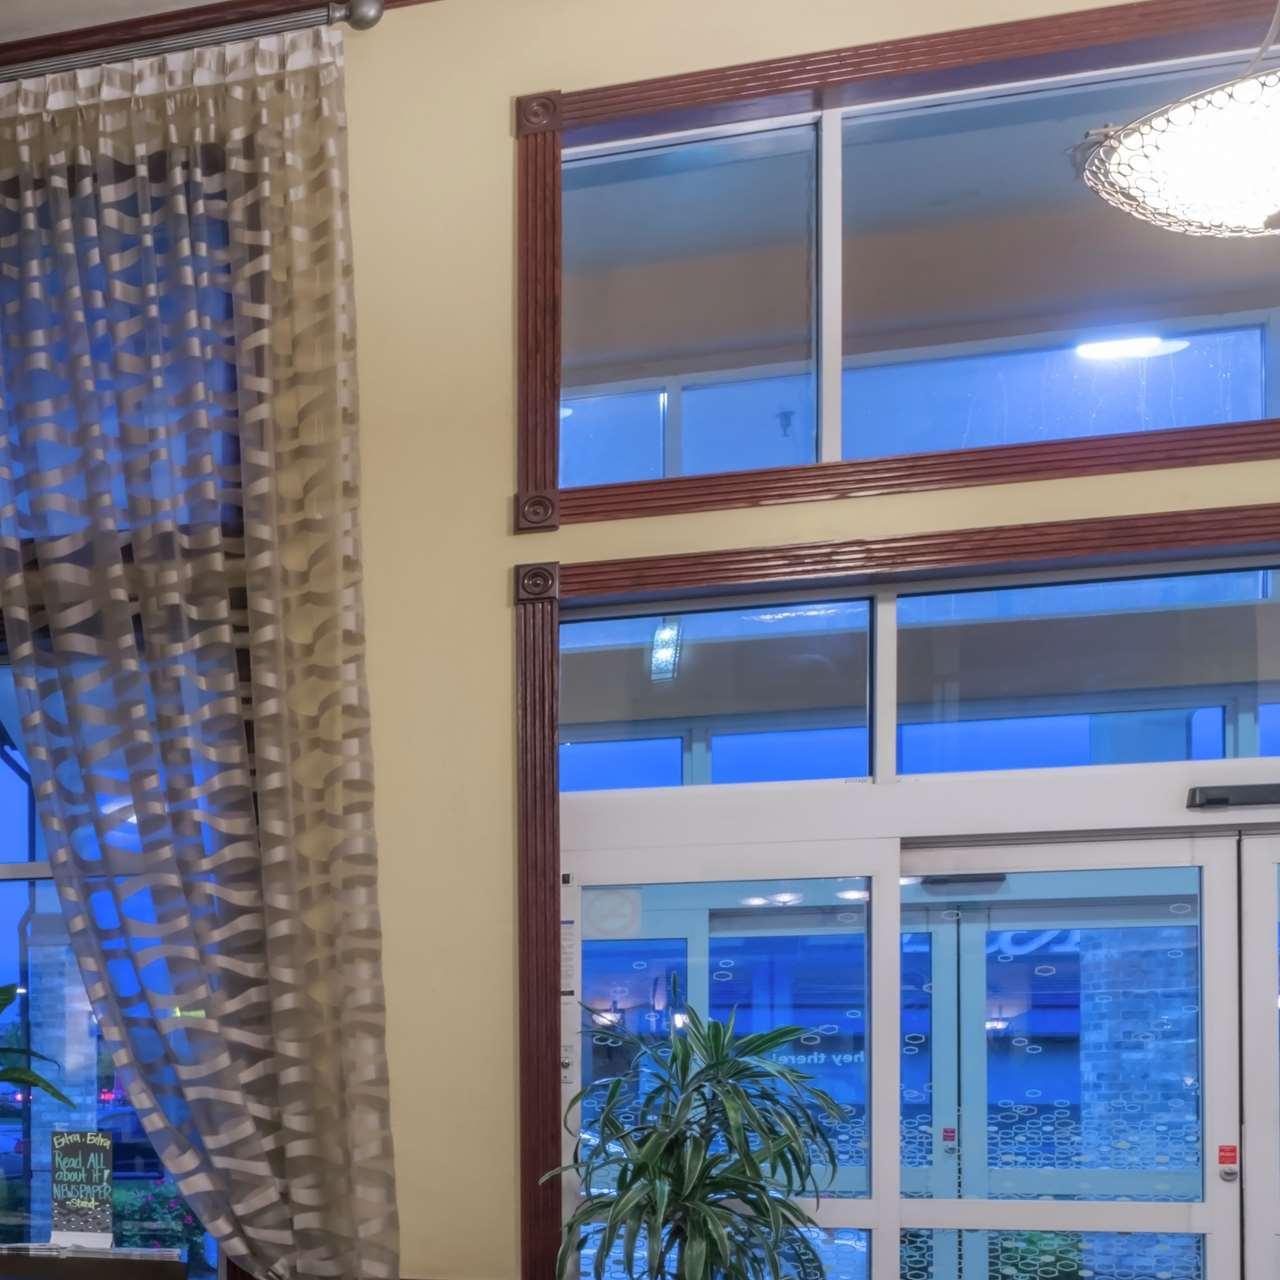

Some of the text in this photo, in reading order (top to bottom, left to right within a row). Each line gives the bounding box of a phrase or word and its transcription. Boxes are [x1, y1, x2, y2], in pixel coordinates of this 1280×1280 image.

[54, 1151, 82, 1169] Read
[55, 1167, 86, 1182] about
[53, 1183, 112, 1200] NEWSPAPER
